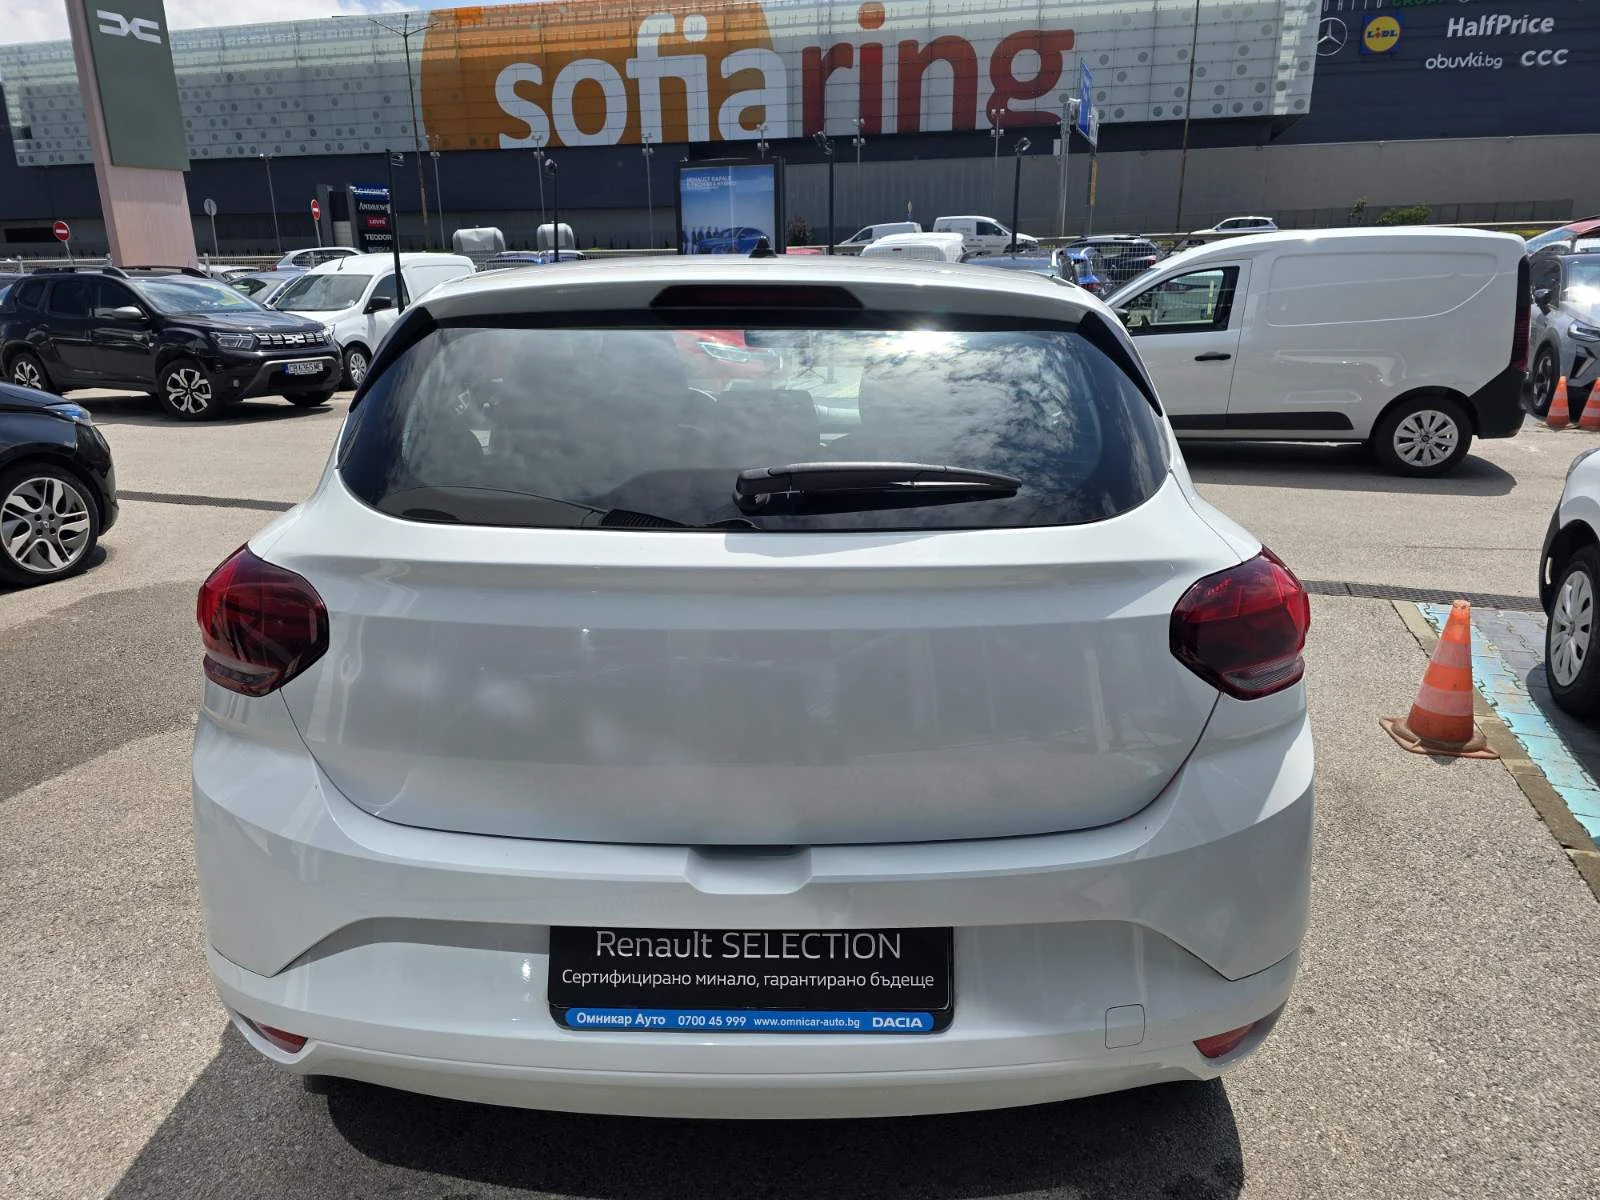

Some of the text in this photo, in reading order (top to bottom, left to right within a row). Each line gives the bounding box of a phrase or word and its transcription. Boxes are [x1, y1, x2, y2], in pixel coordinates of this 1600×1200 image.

[1446, 14, 1555, 38] HalfPrice
[1425, 52, 1503, 70] obuvki.bg
[1520, 49, 1569, 67] CCC
[596, 930, 901, 960] Renault SELECTION
[562, 969, 934, 990] Сертифицирано минало, гарантирано бъдеще
[576, 1012, 923, 1029] Омникар Ауто 0700 45 999 www.omnicar-auto.bg DACIA
